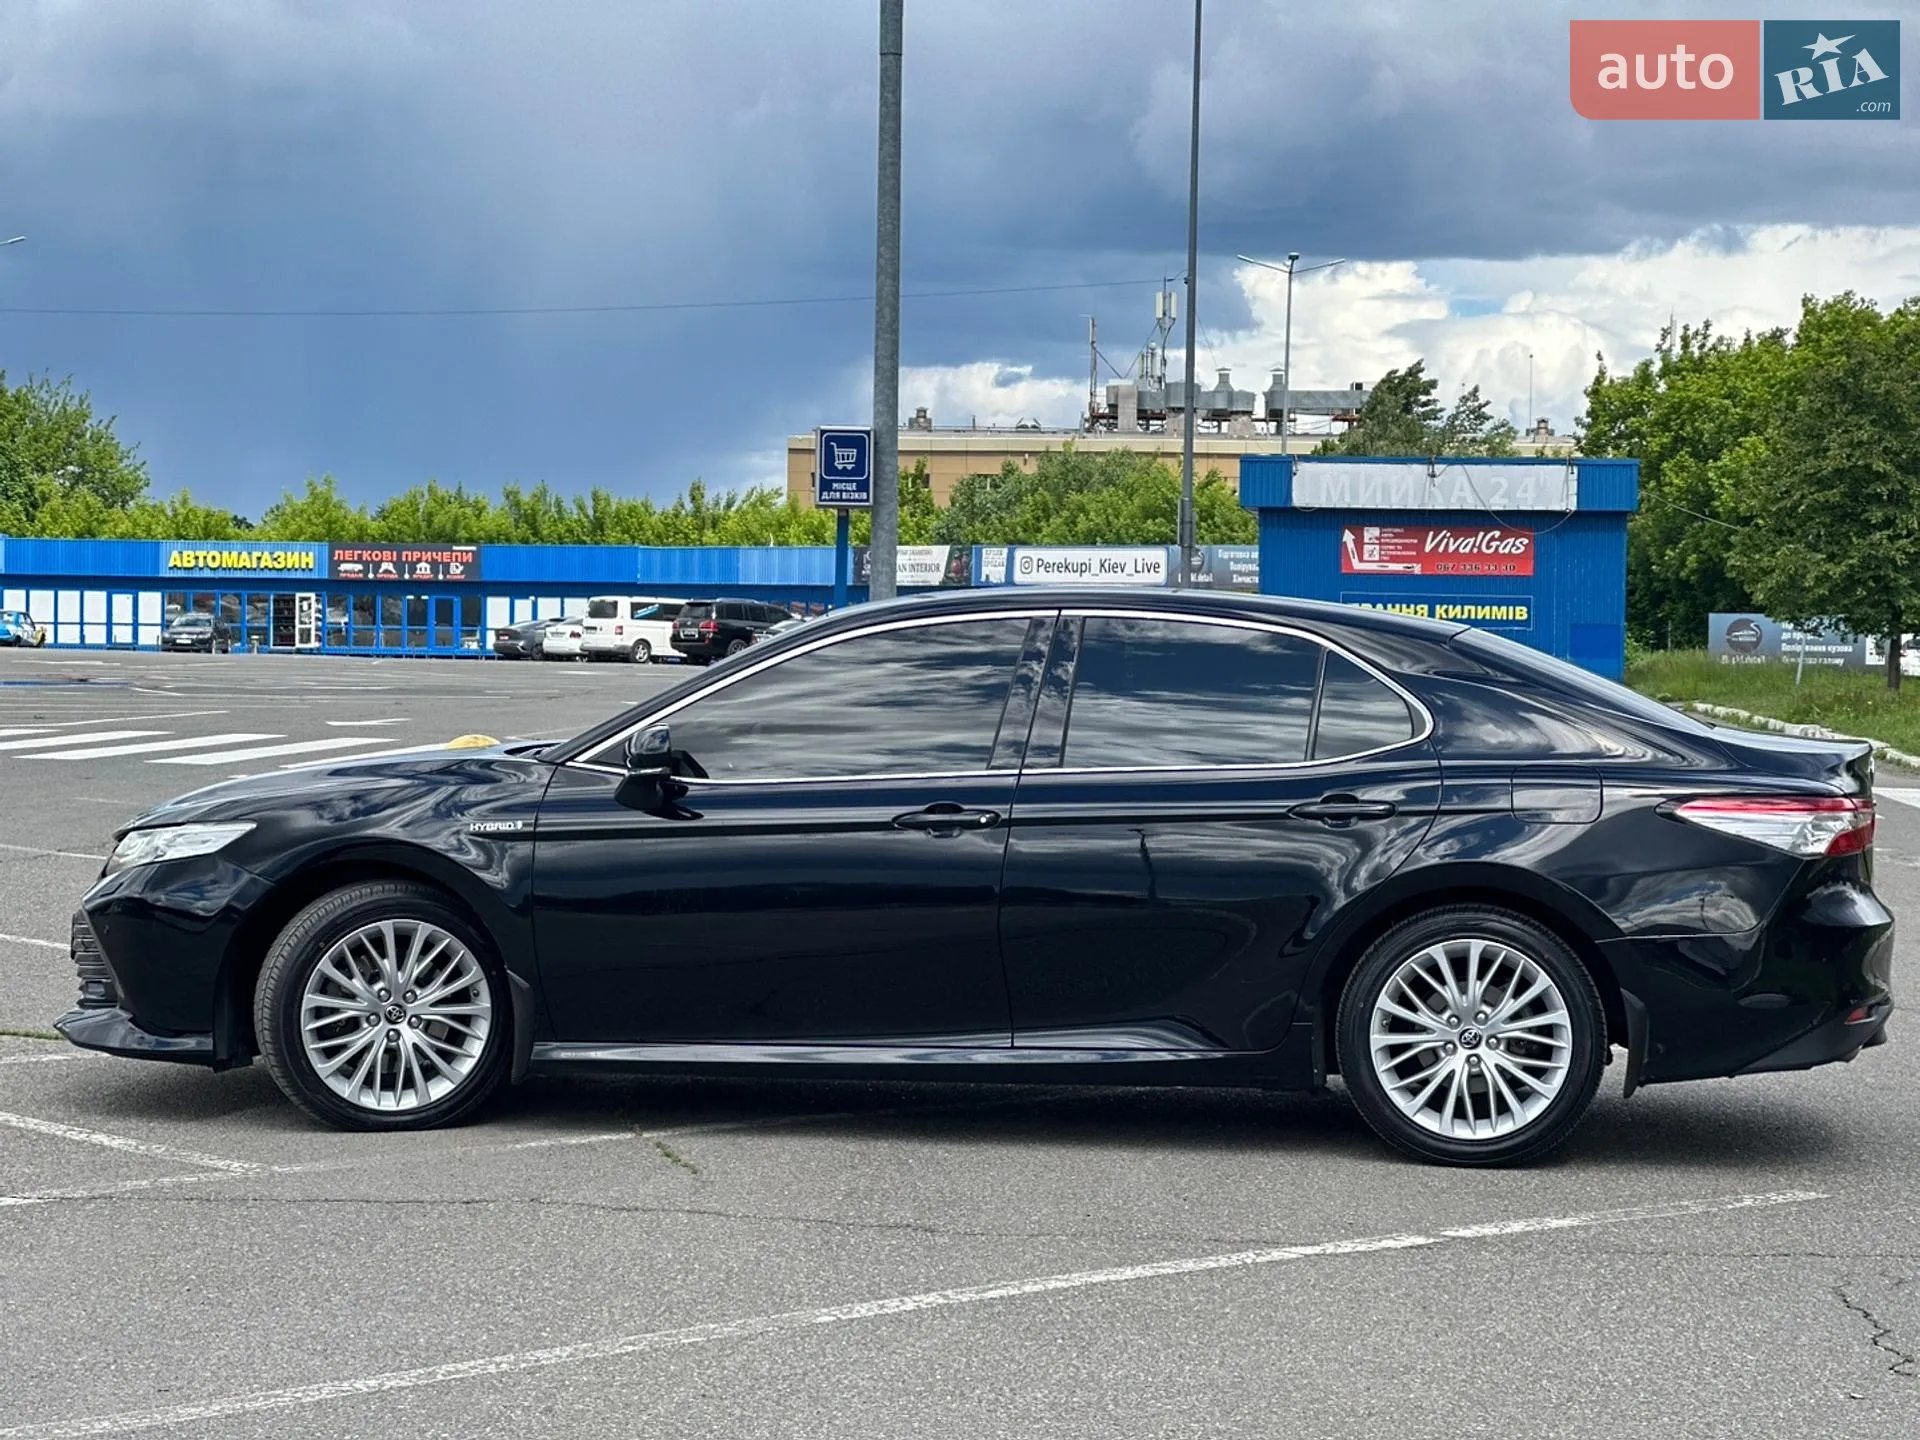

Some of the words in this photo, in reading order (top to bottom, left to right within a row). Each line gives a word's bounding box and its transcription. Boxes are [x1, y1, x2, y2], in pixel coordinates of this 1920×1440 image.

[832, 483, 857, 491] МІСЦЕ
[821, 491, 841, 500] ДЛЯ
[841, 491, 867, 500] ВІЗКІВ
[1424, 529, 1529, 554] Viva!Gas
[168, 551, 314, 571] АВТОМАГАЗИН
[333, 550, 397, 561] ЛЕГКОВІ
[401, 551, 473, 562] ПРИЧЕПИ
[908, 562, 941, 573] INTERIOR
[1036, 557, 1161, 578] Perekupi_Kiev_Live
[1434, 604, 1529, 621] КИЛИМІВ
[471, 823, 515, 831] HYBRID
